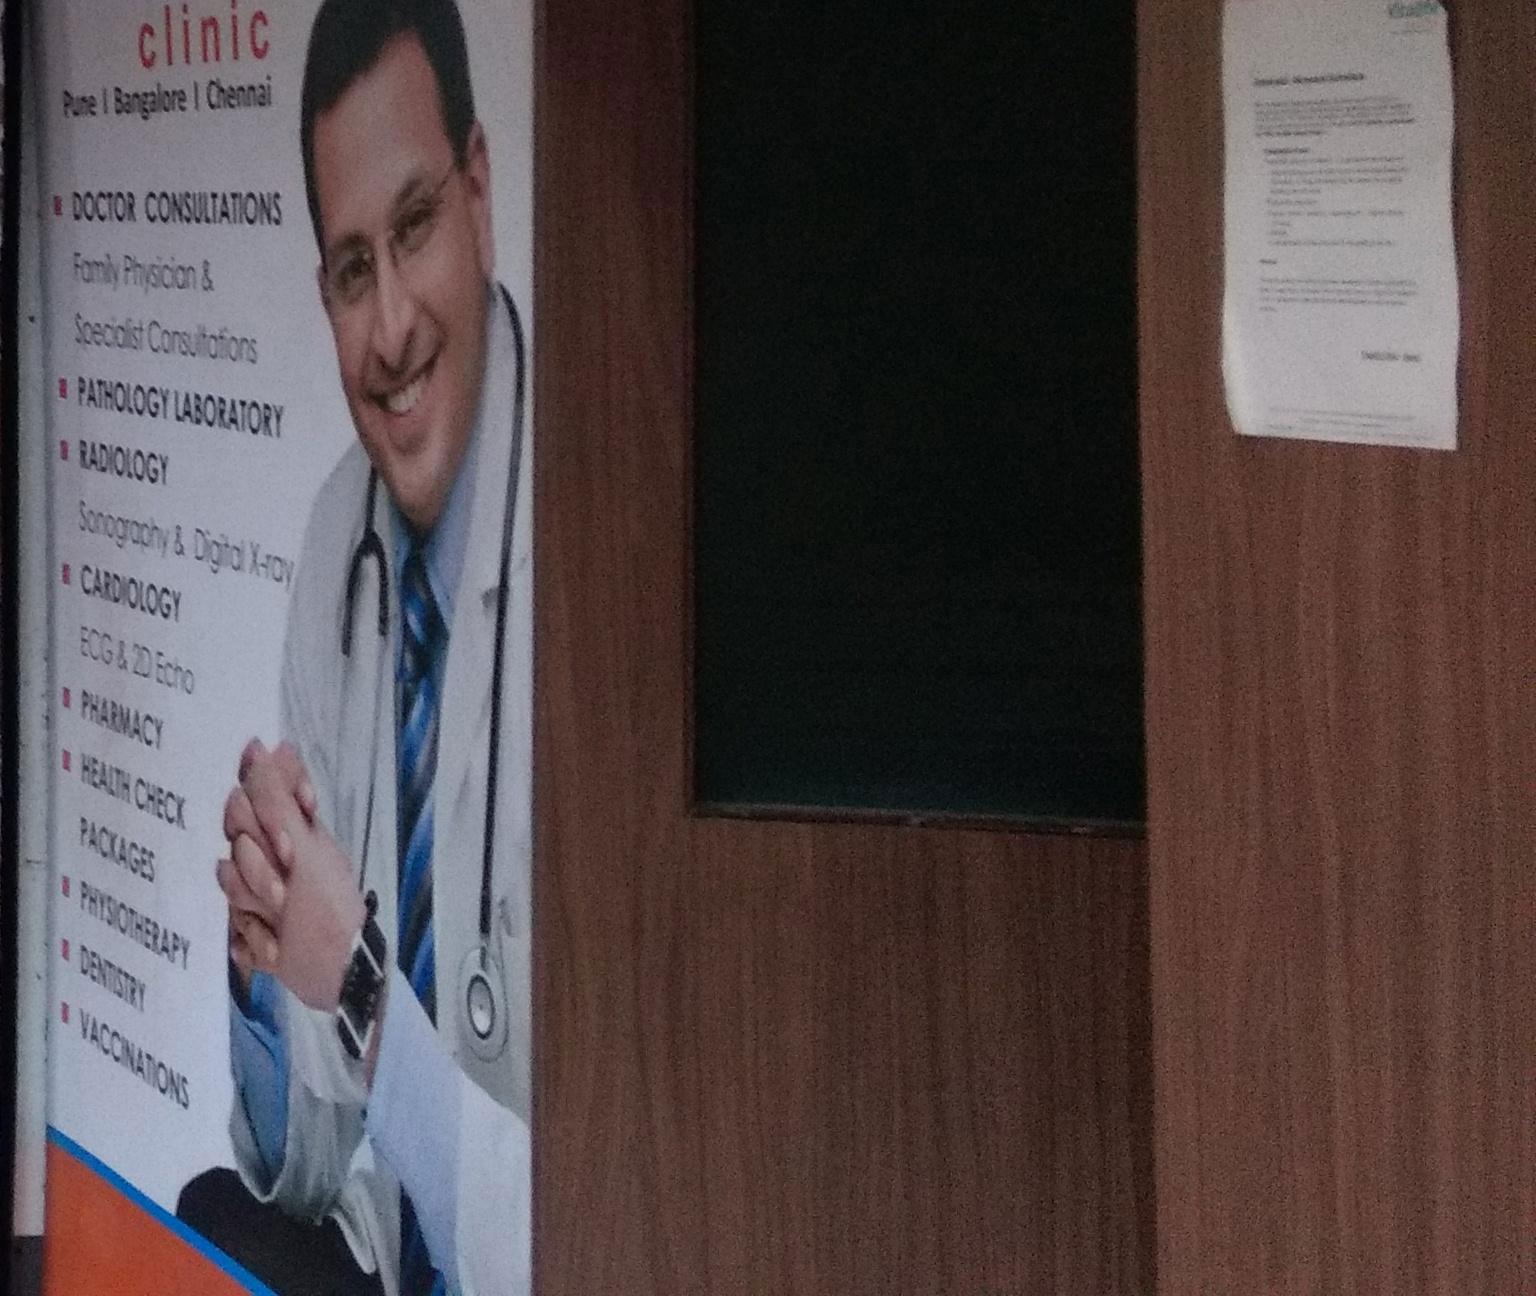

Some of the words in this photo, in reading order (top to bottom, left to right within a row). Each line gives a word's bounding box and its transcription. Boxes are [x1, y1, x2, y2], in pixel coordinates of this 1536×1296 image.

[63, 89, 97, 117] Pune
[114, 82, 187, 120] Bangalore
[206, 75, 272, 111] Chennai
[72, 191, 136, 222] DOCTOR
[144, 192, 283, 225] CONSULTATIONS
[73, 252, 118, 291] Family
[124, 254, 196, 293] Physician
[202, 259, 214, 292] &
[75, 313, 144, 352] Specialist
[147, 320, 258, 364] Consultations
[78, 376, 170, 419] PATHOLOGY
[175, 391, 284, 438] LABORATORY
[79, 439, 169, 485] RADIOLOGY
[79, 500, 170, 558] Sonography
[175, 524, 185, 556] &
[194, 528, 246, 574] Digital
[80, 564, 182, 621] CARDIOLOGY
[80, 625, 114, 666] ECG
[117, 640, 128, 670] &
[132, 644, 153, 679] 2D
[155, 652, 195, 695] Echo
[81, 689, 164, 750] PHARMACY
[80, 752, 132, 798] HEALTH
[134, 777, 187, 830] CHECK
[79, 816, 156, 883] PACKAGES
[79, 881, 191, 970] PHYSIOTHERAPY
[79, 944, 146, 1012] DENTISTRY
[79, 1006, 191, 1111] VACCINATIONS
